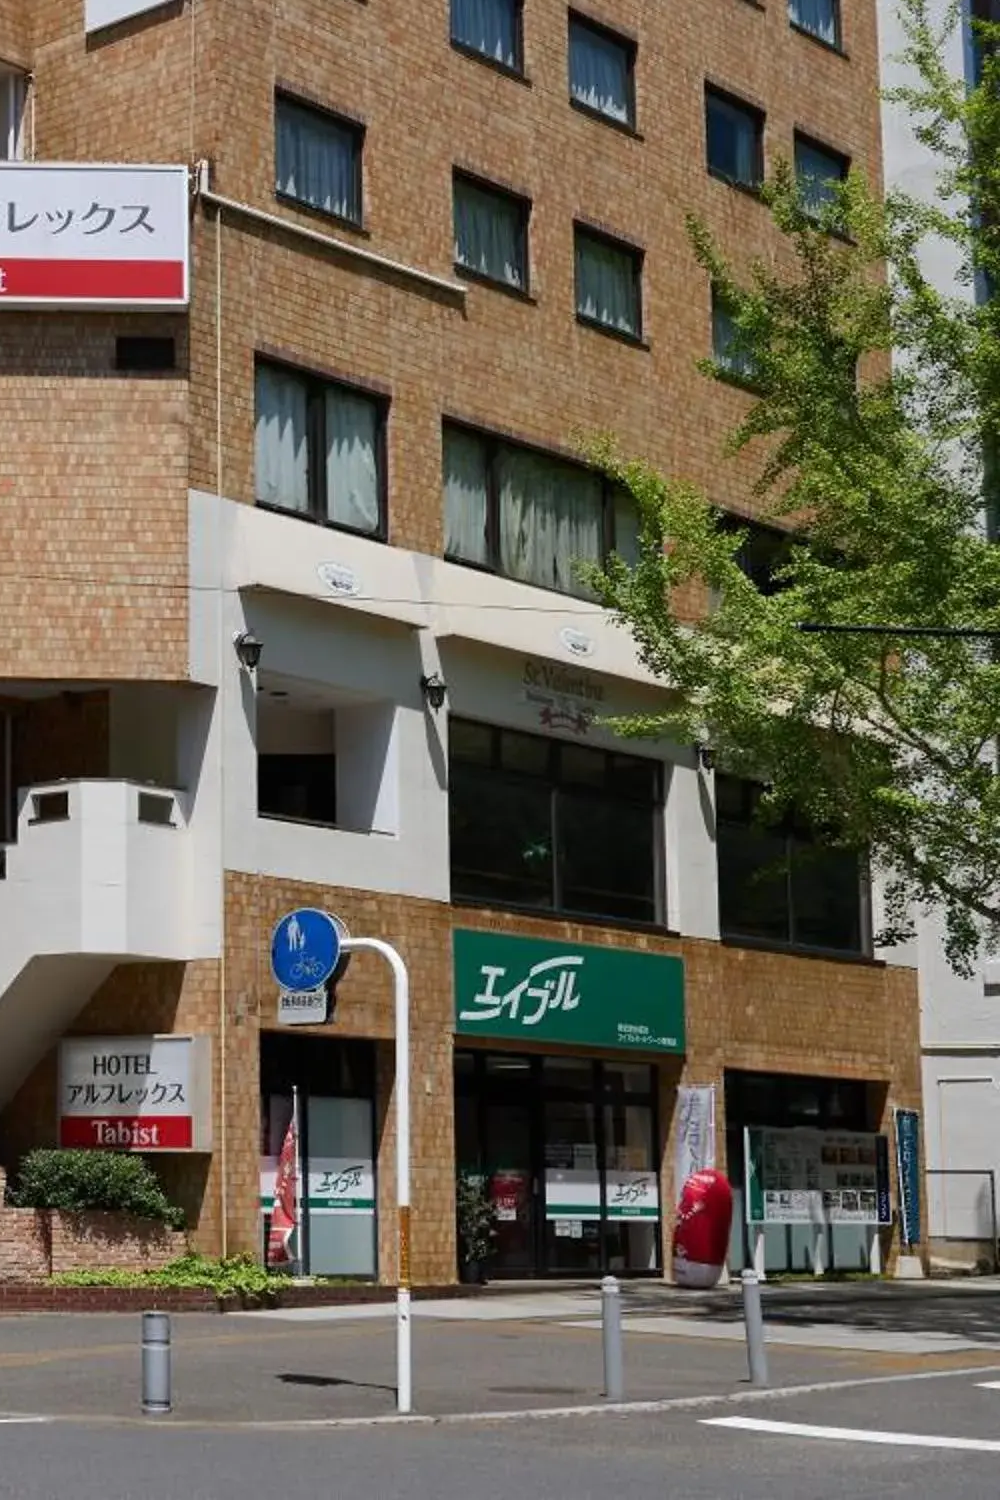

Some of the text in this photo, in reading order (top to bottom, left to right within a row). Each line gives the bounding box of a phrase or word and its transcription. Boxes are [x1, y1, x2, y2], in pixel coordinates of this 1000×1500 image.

[459, 955, 585, 1026] エイブル
[93, 1054, 158, 1075] HOTEL
[67, 1083, 185, 1105] アルフレックス
[91, 1121, 159, 1144] Tabist
[315, 1165, 364, 1193] エイブル
